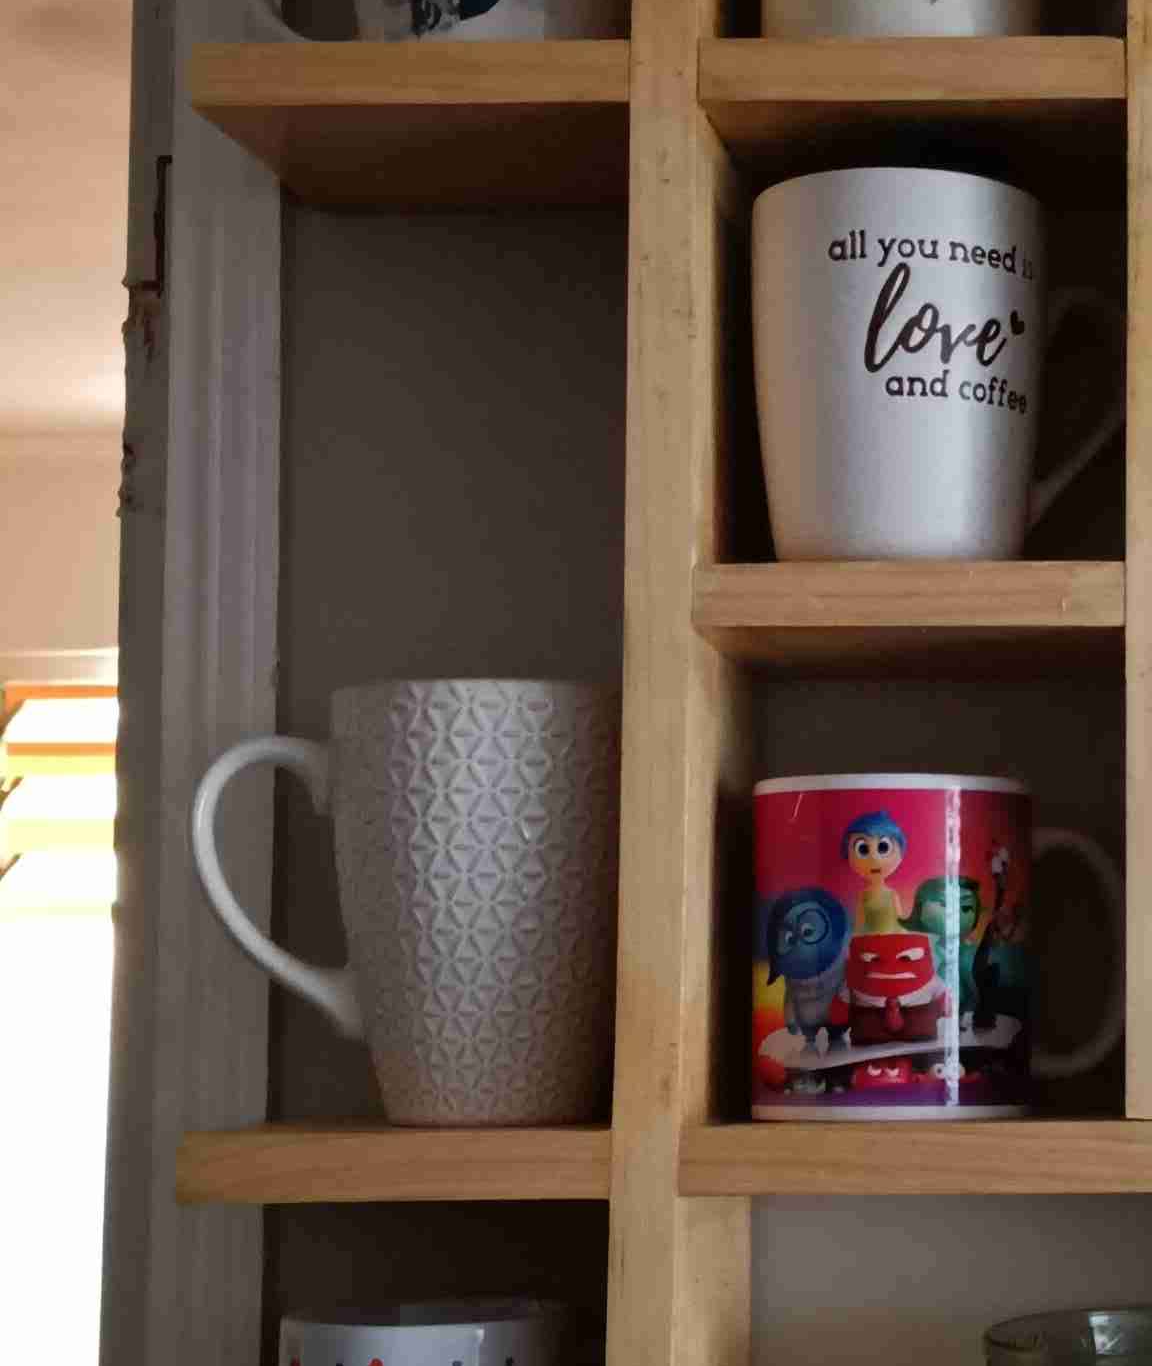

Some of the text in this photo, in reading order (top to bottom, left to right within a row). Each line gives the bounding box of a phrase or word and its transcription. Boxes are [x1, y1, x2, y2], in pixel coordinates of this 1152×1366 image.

[828, 230, 867, 262] all
[876, 238, 939, 268] you
[949, 241, 1017, 274] need
[864, 262, 1007, 373] love
[885, 369, 1028, 414] and coffee
